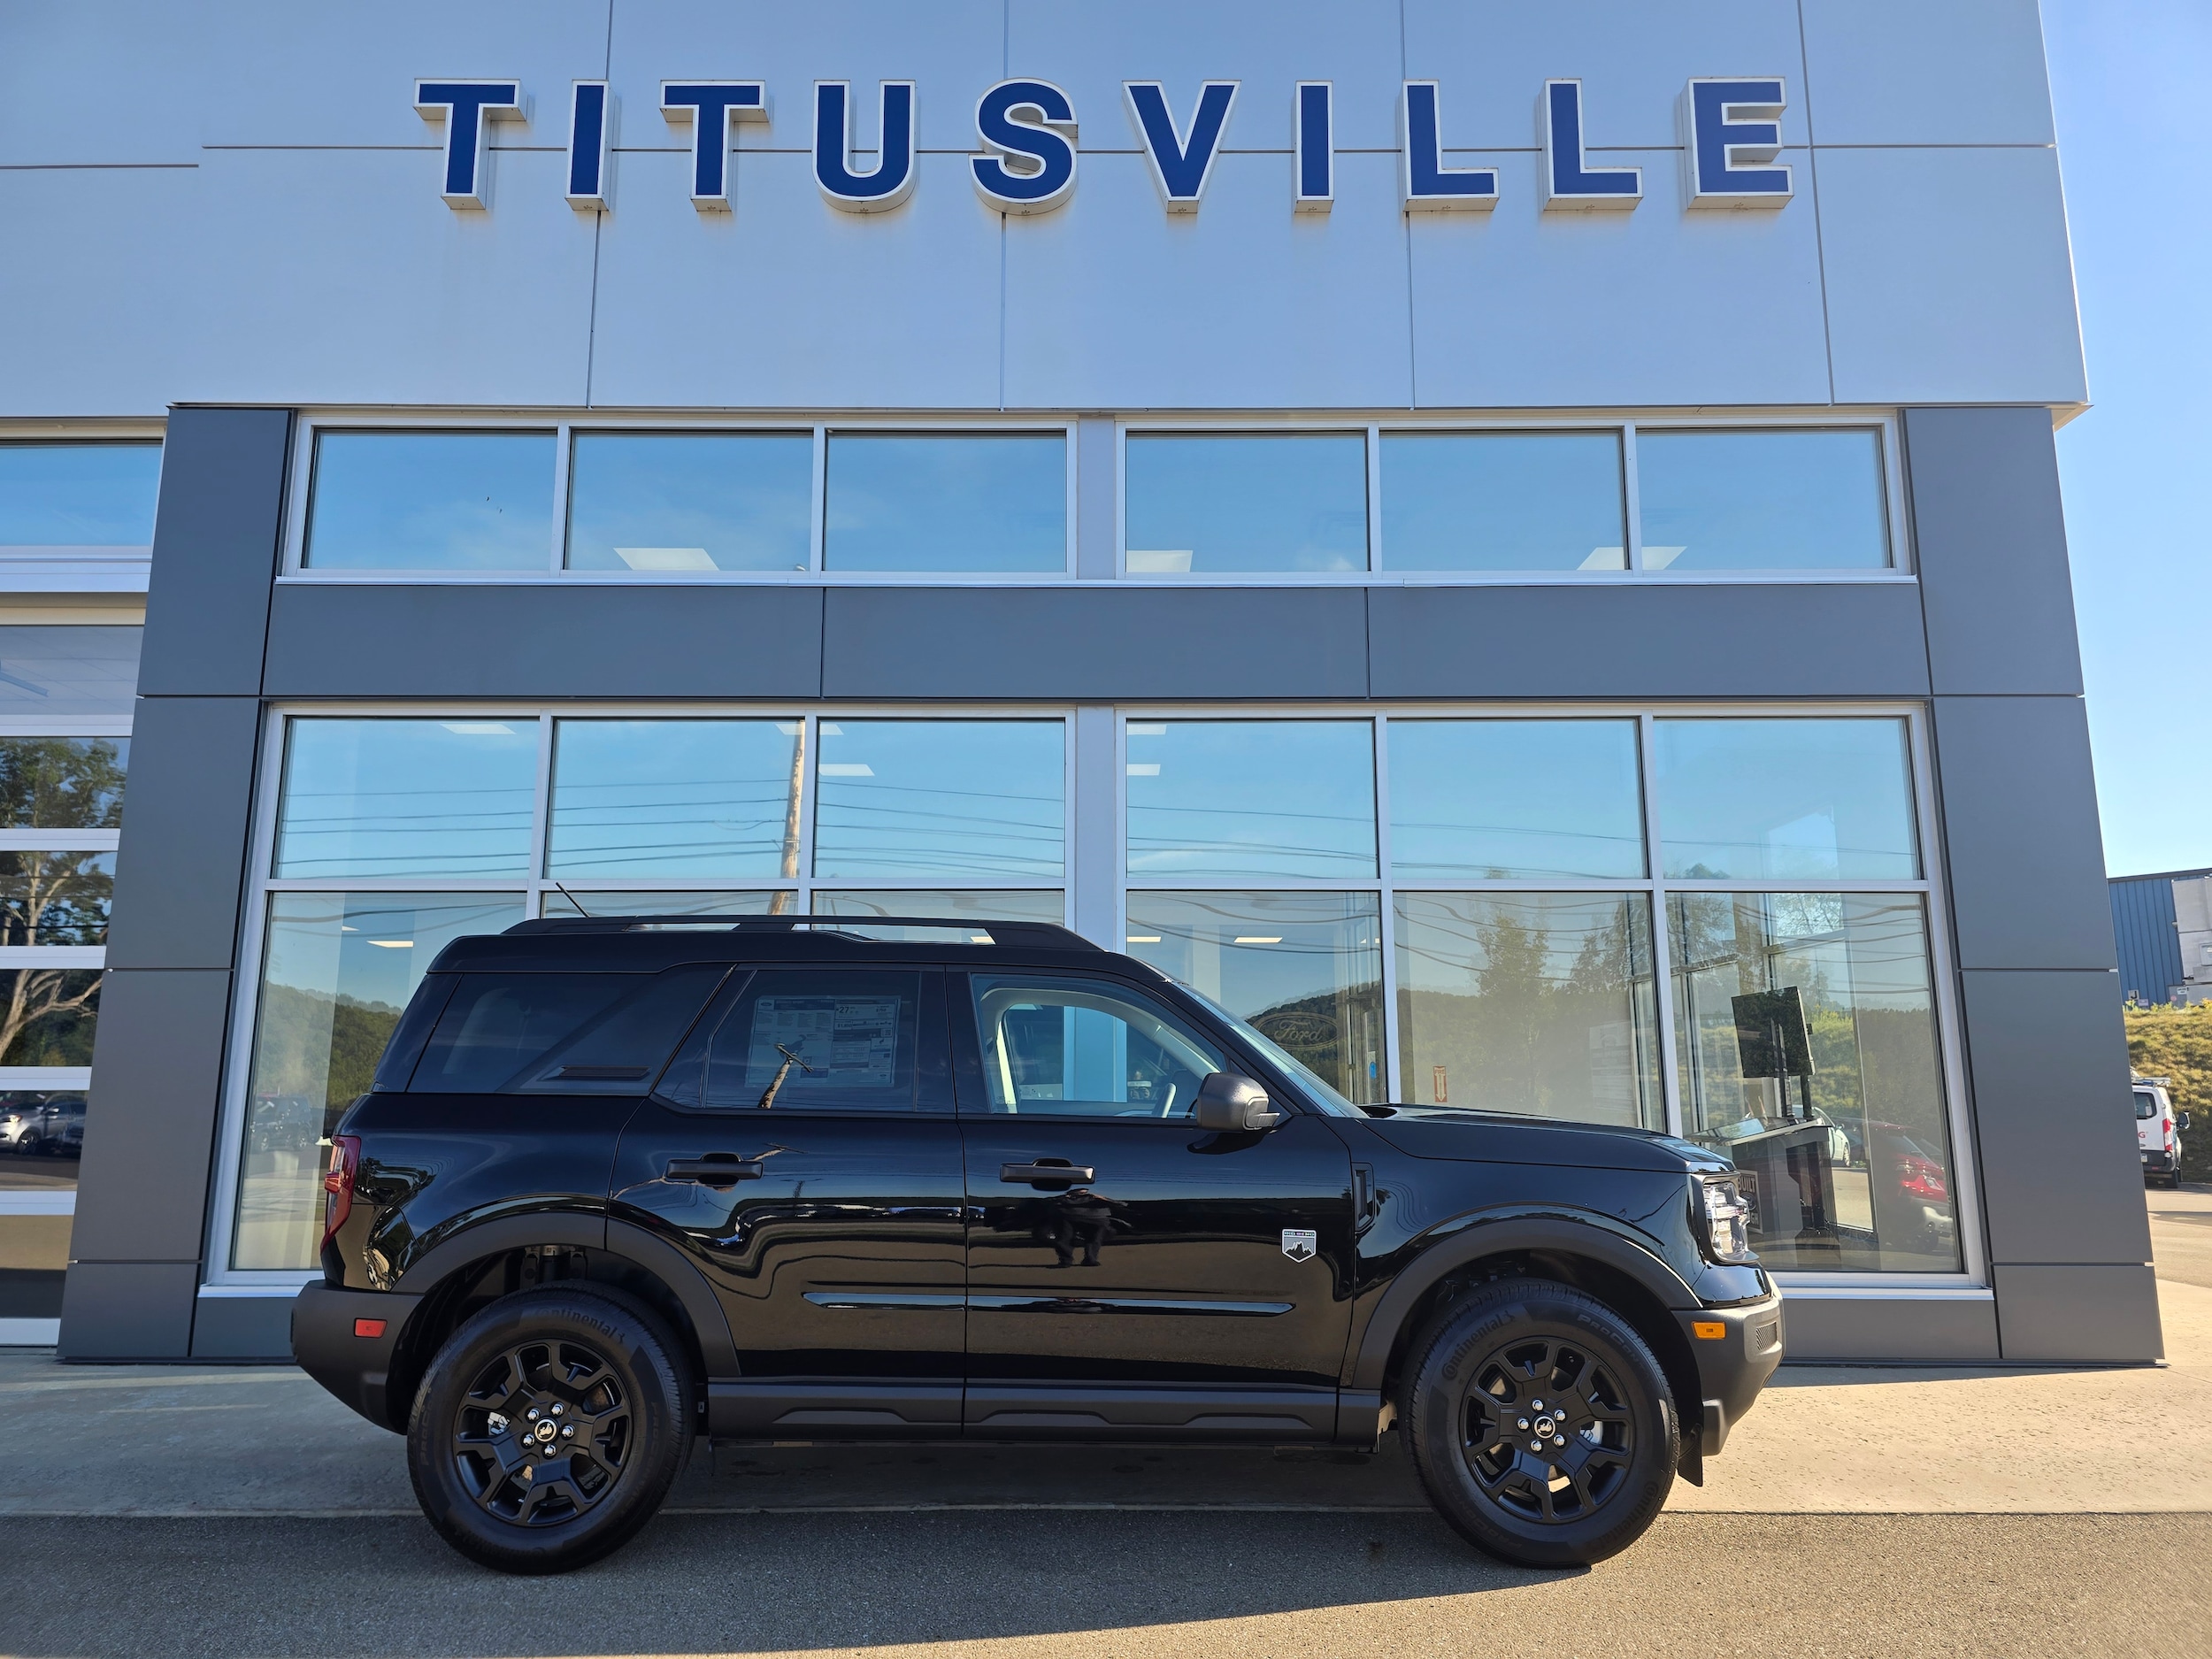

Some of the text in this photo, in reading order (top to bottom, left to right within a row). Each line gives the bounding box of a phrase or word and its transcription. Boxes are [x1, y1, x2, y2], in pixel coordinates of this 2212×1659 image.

[413, 77, 1794, 210] TITUSVILLE
[1273, 1019, 1324, 1042] Ford
[1738, 1177, 1755, 1193] BUILT
[534, 1309, 618, 1340] Continental
[1440, 1317, 1505, 1381] Continental
